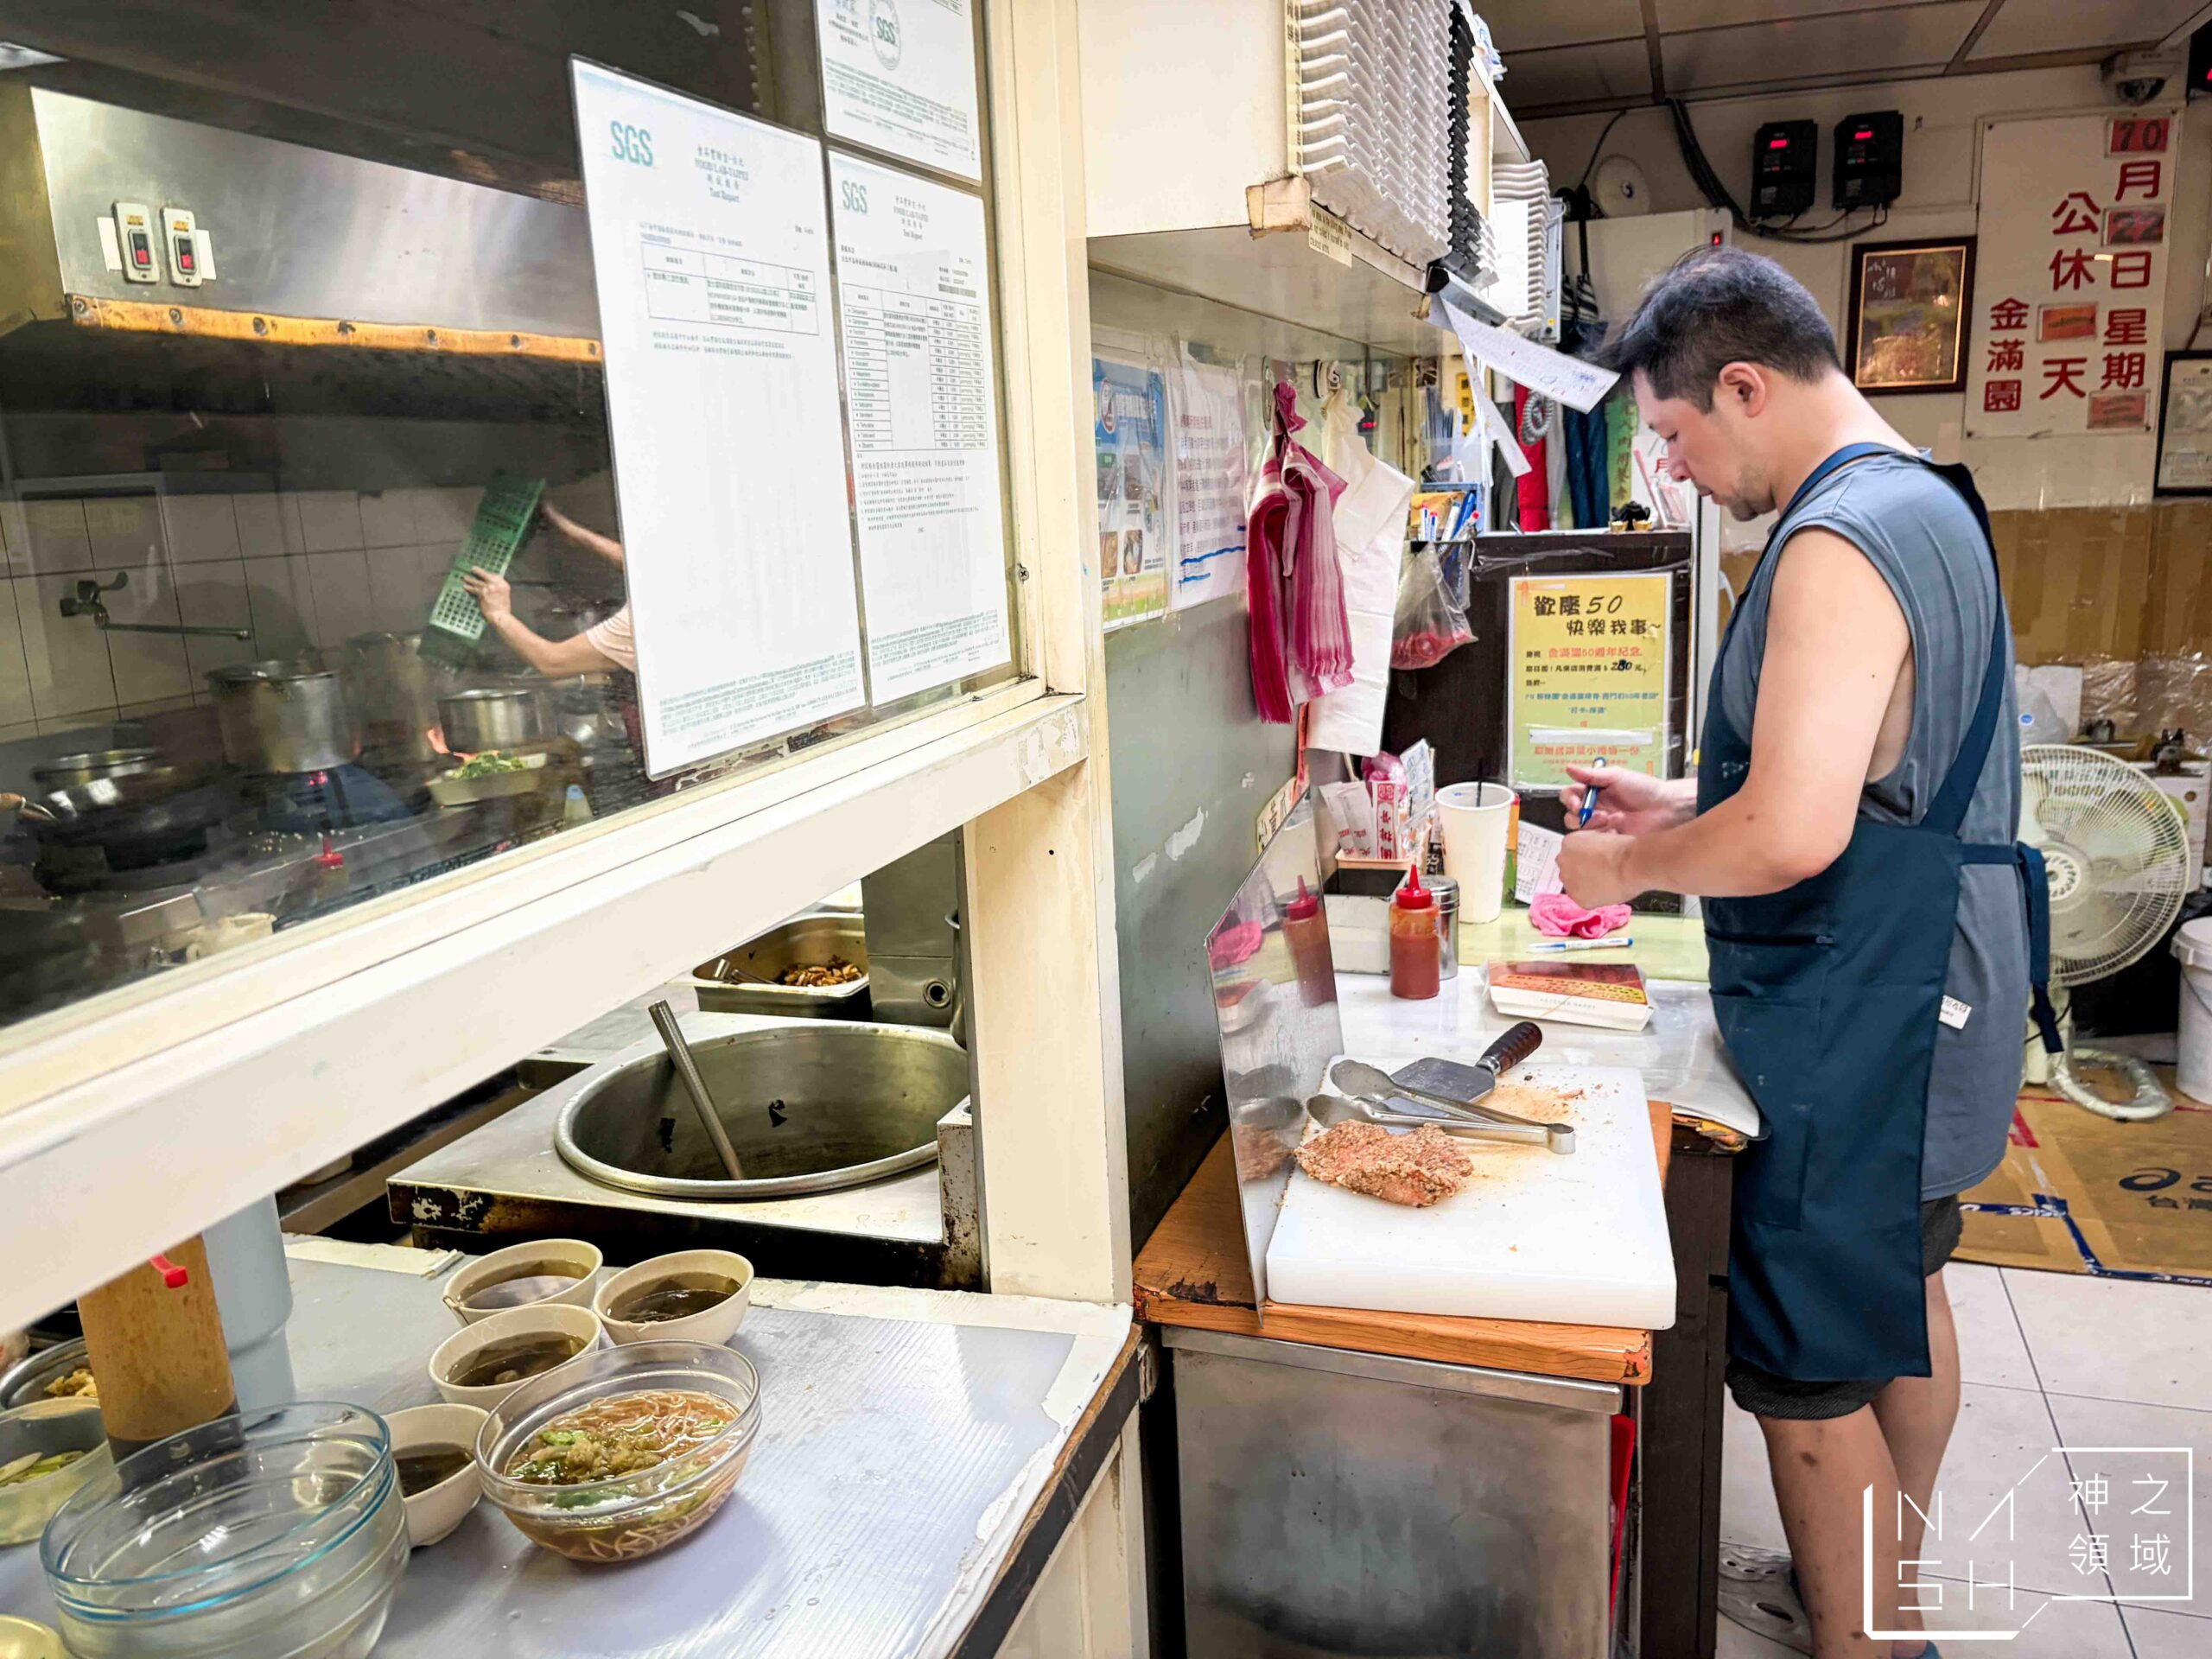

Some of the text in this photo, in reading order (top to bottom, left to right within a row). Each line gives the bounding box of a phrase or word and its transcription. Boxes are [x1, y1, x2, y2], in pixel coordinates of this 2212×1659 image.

[876, 16, 895, 44] SGS
[610, 120, 654, 167] SGS
[842, 180, 868, 214] SGS
[1984, 297, 2030, 412] 金滿園
